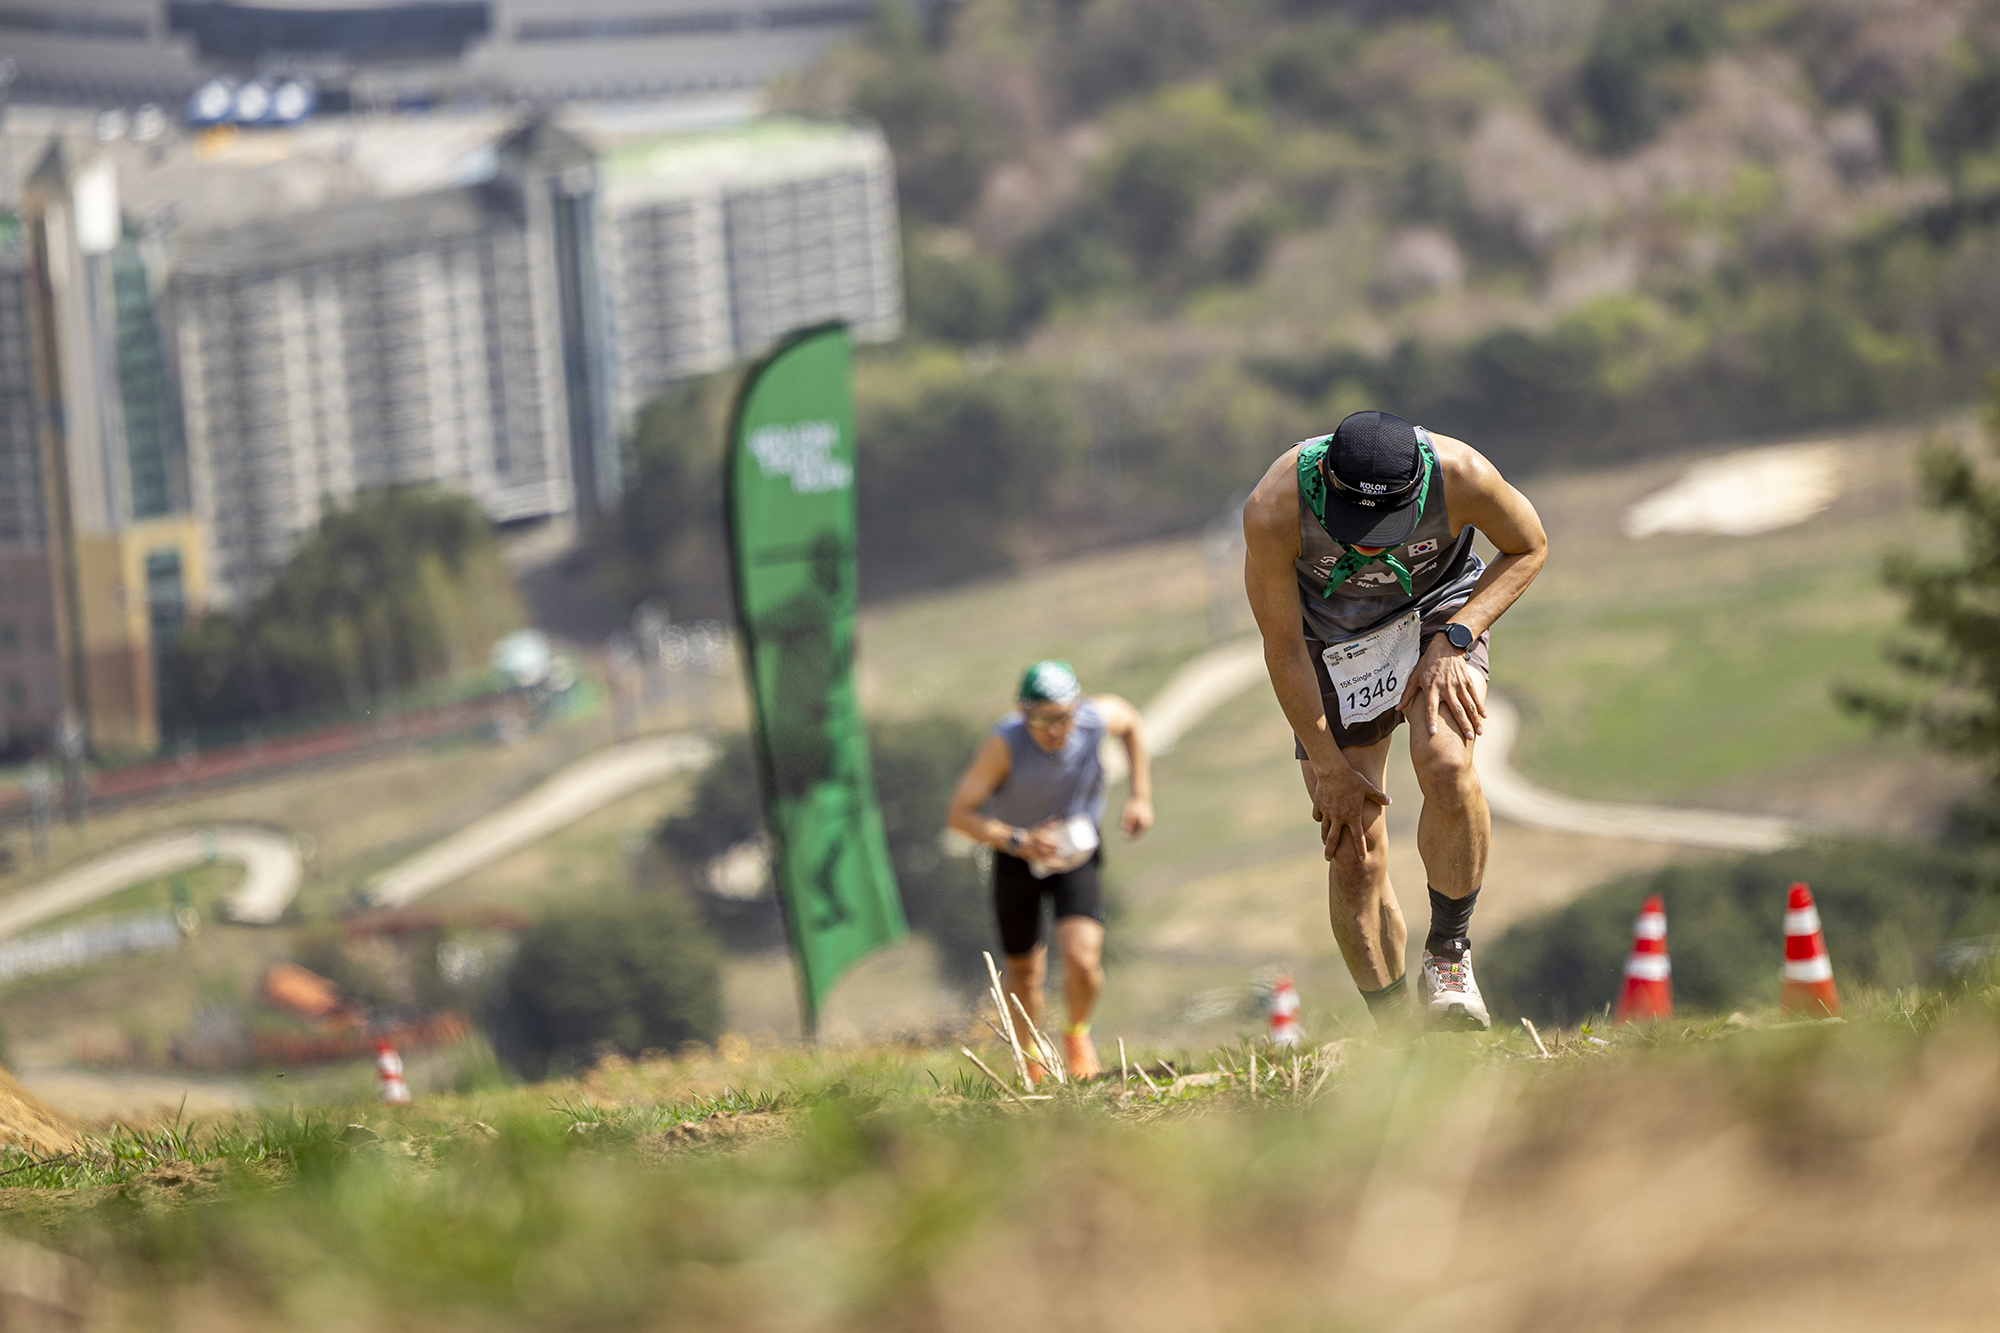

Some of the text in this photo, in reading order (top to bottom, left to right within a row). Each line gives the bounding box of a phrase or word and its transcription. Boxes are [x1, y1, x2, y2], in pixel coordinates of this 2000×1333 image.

[1360, 481, 1387, 492] KOLON
[1358, 498, 1376, 507] 026
[1340, 679, 1352, 689] 15K
[1352, 671, 1372, 685] Single
[1346, 670, 1398, 710] 1346
